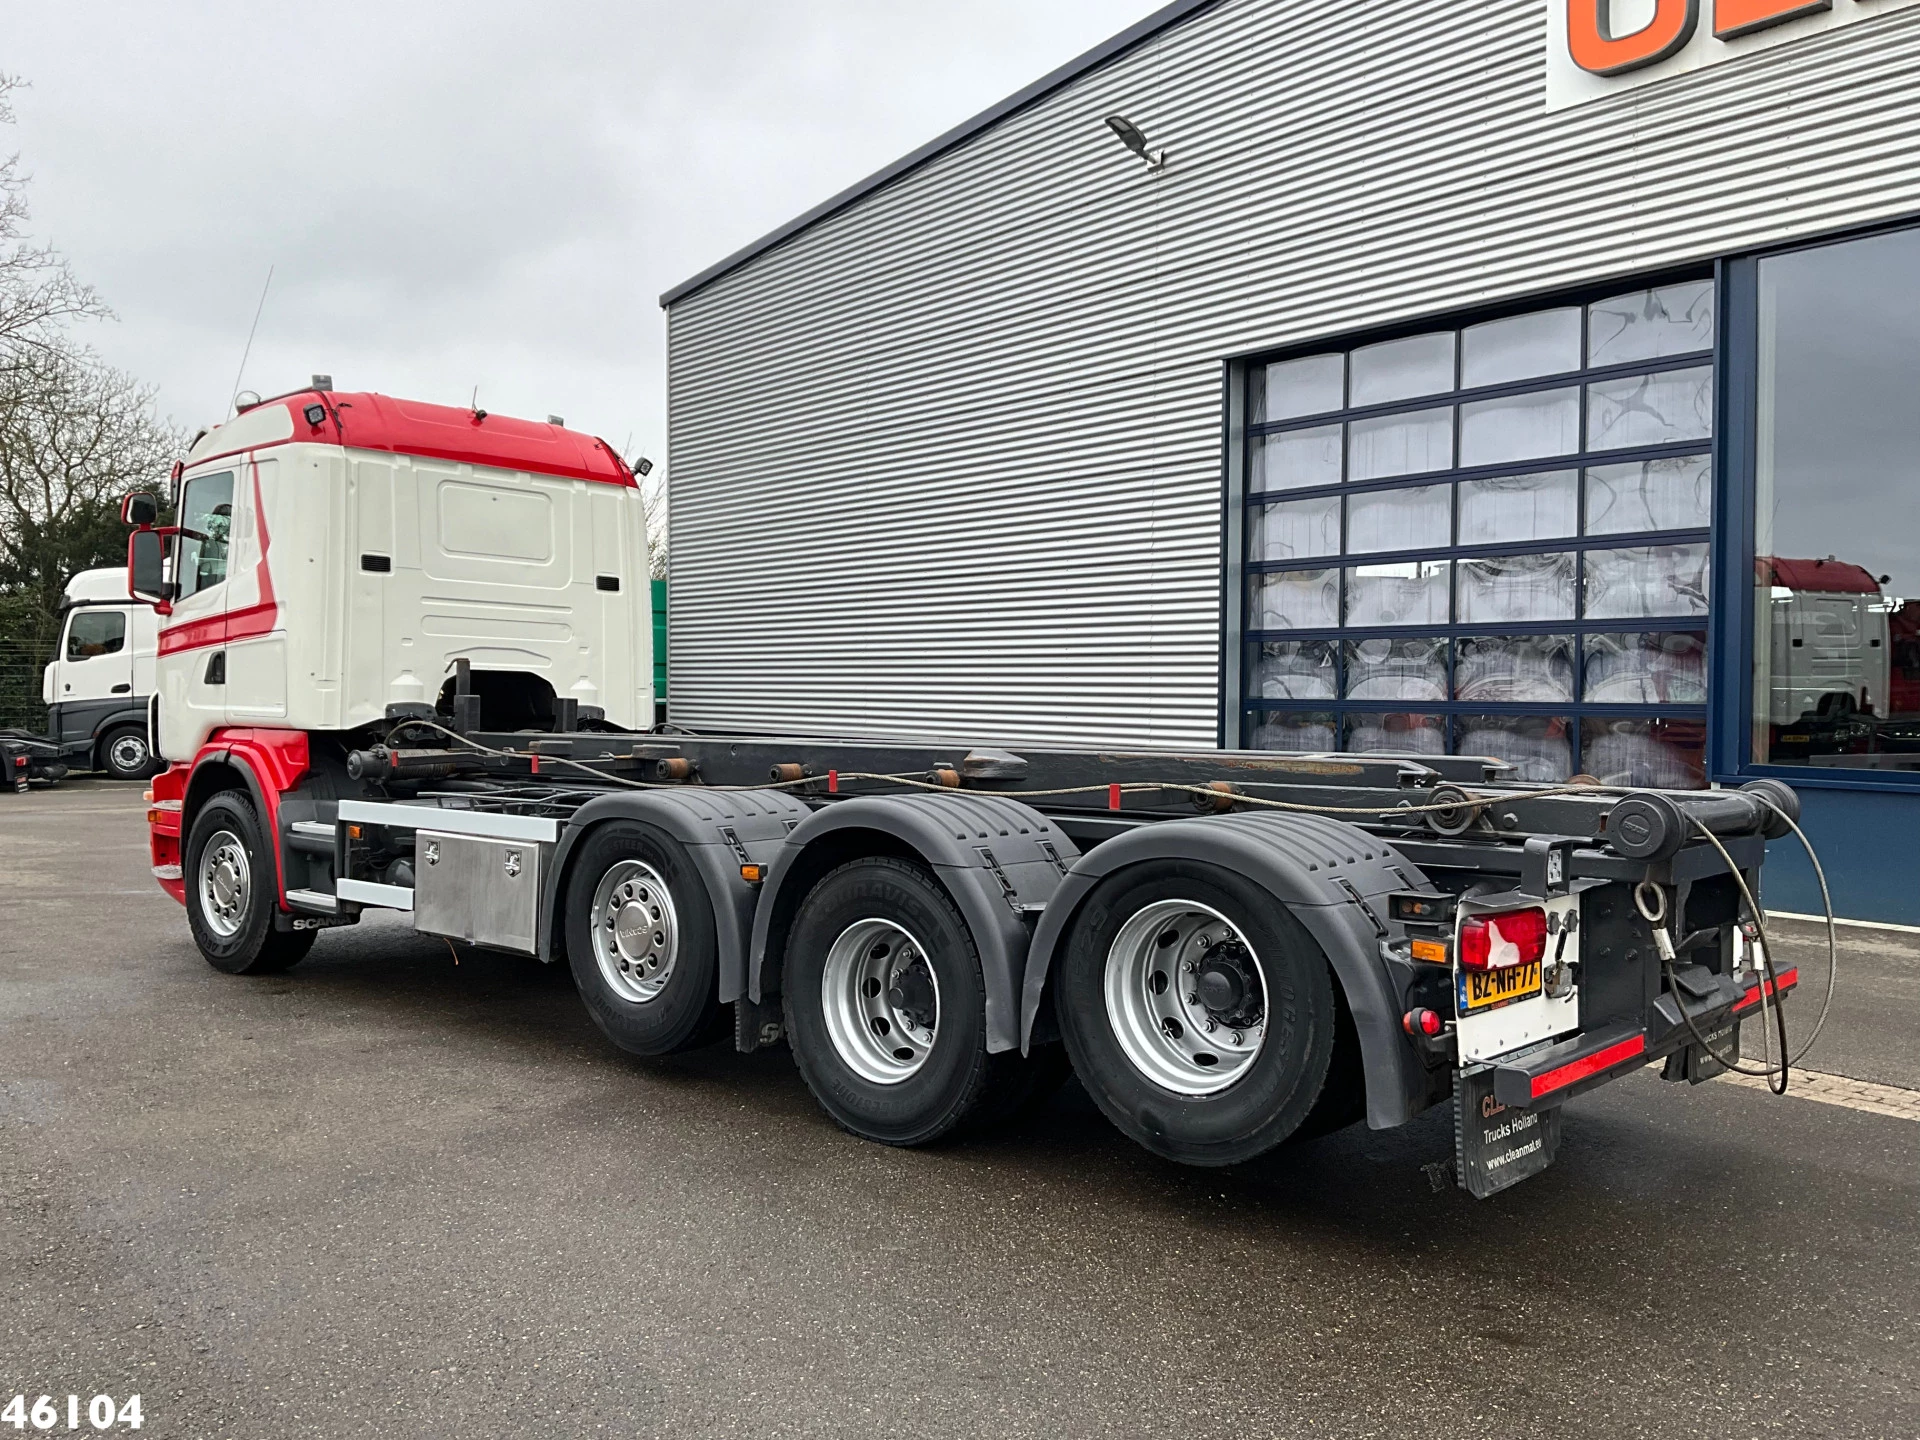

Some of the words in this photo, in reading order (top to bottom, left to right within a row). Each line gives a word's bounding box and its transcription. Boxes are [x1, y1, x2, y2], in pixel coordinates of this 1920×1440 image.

[1472, 963, 1535, 1001] BZ-NH-77
[1484, 1123, 1511, 1145] Trucks
[1511, 1112, 1538, 1134] Holland
